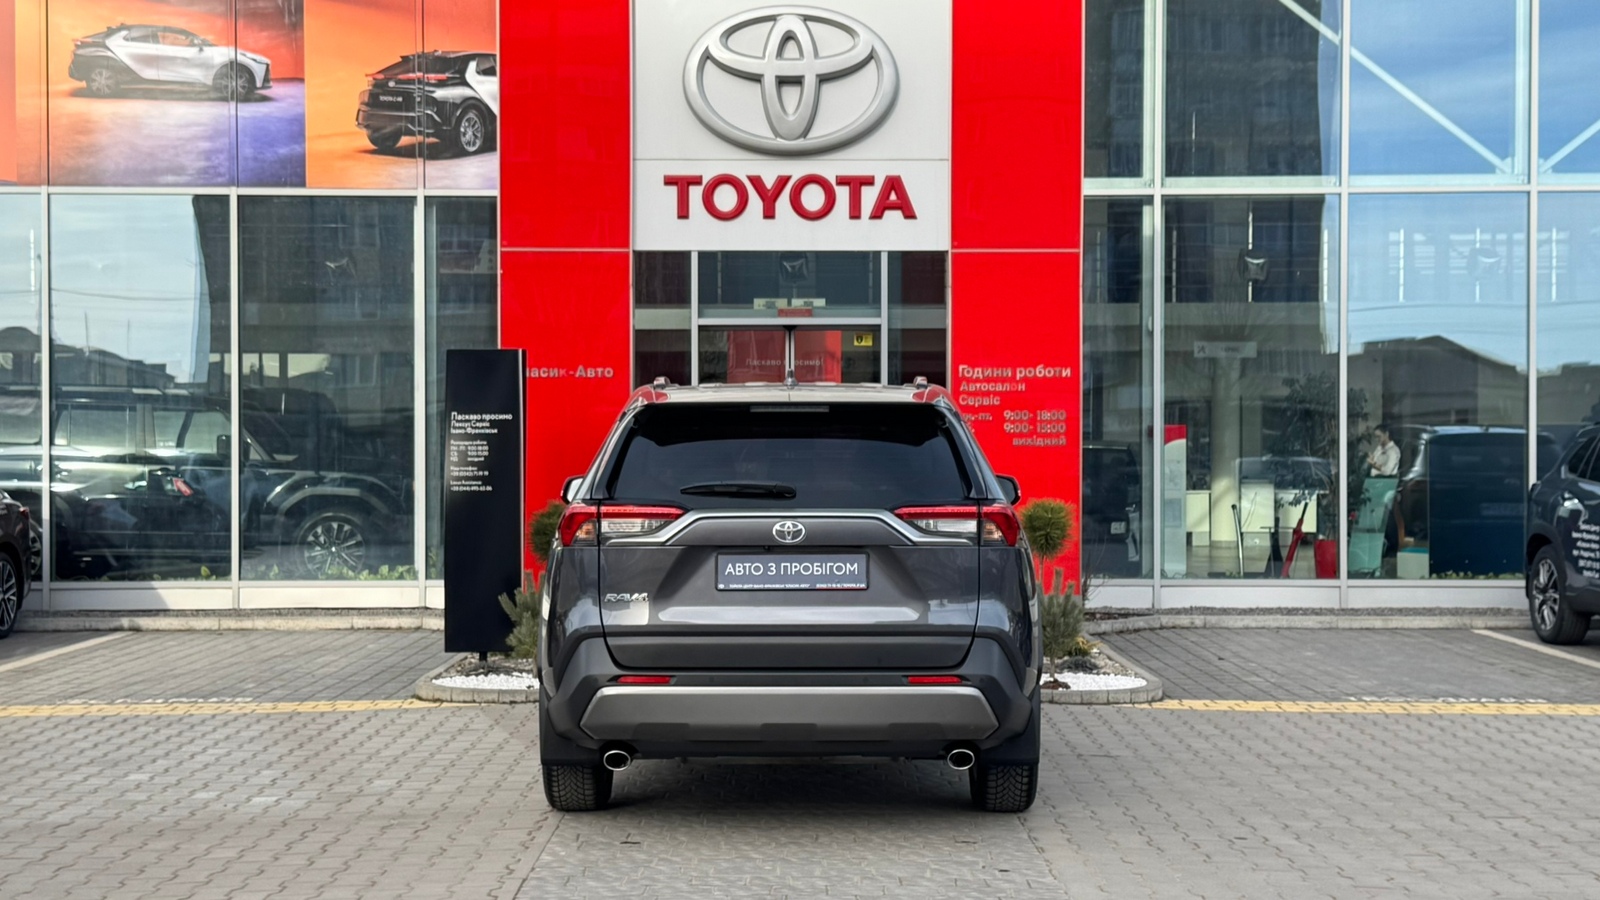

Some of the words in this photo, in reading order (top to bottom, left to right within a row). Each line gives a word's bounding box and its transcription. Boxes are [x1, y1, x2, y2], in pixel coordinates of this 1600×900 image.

[663, 173, 918, 221] TOYOTA
[958, 364, 1013, 379] Години
[1016, 364, 1072, 381] роботи
[960, 381, 1026, 392] Автосалон
[959, 394, 1001, 408] Сервіс
[482, 413, 513, 422] просимо
[1012, 435, 1067, 447] вихідний
[724, 562, 764, 577] АВТО
[767, 562, 777, 576] З
[780, 562, 858, 577] ПРОБІГОМ
[604, 592, 649, 603] RAV4
